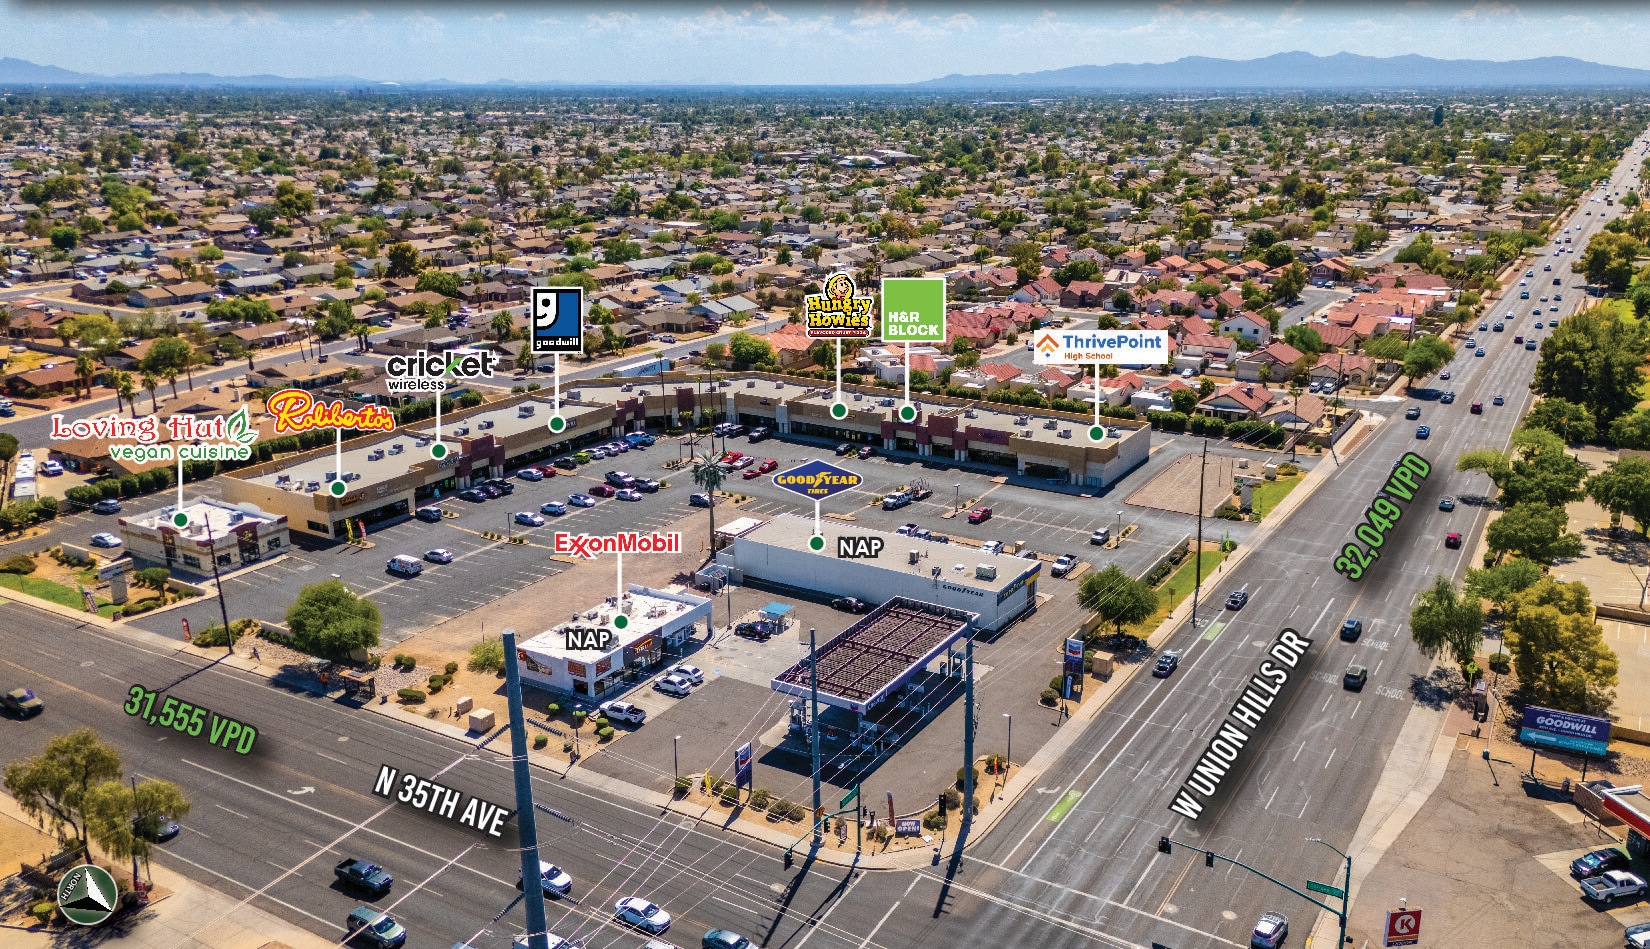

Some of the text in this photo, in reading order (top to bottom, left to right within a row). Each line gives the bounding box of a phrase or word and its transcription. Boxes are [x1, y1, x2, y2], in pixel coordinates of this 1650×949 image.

[1361, 637, 1389, 651] SCHOOL
[1375, 685, 1405, 700] SCHOOL
[1536, 716, 1598, 735] GOODWILL
